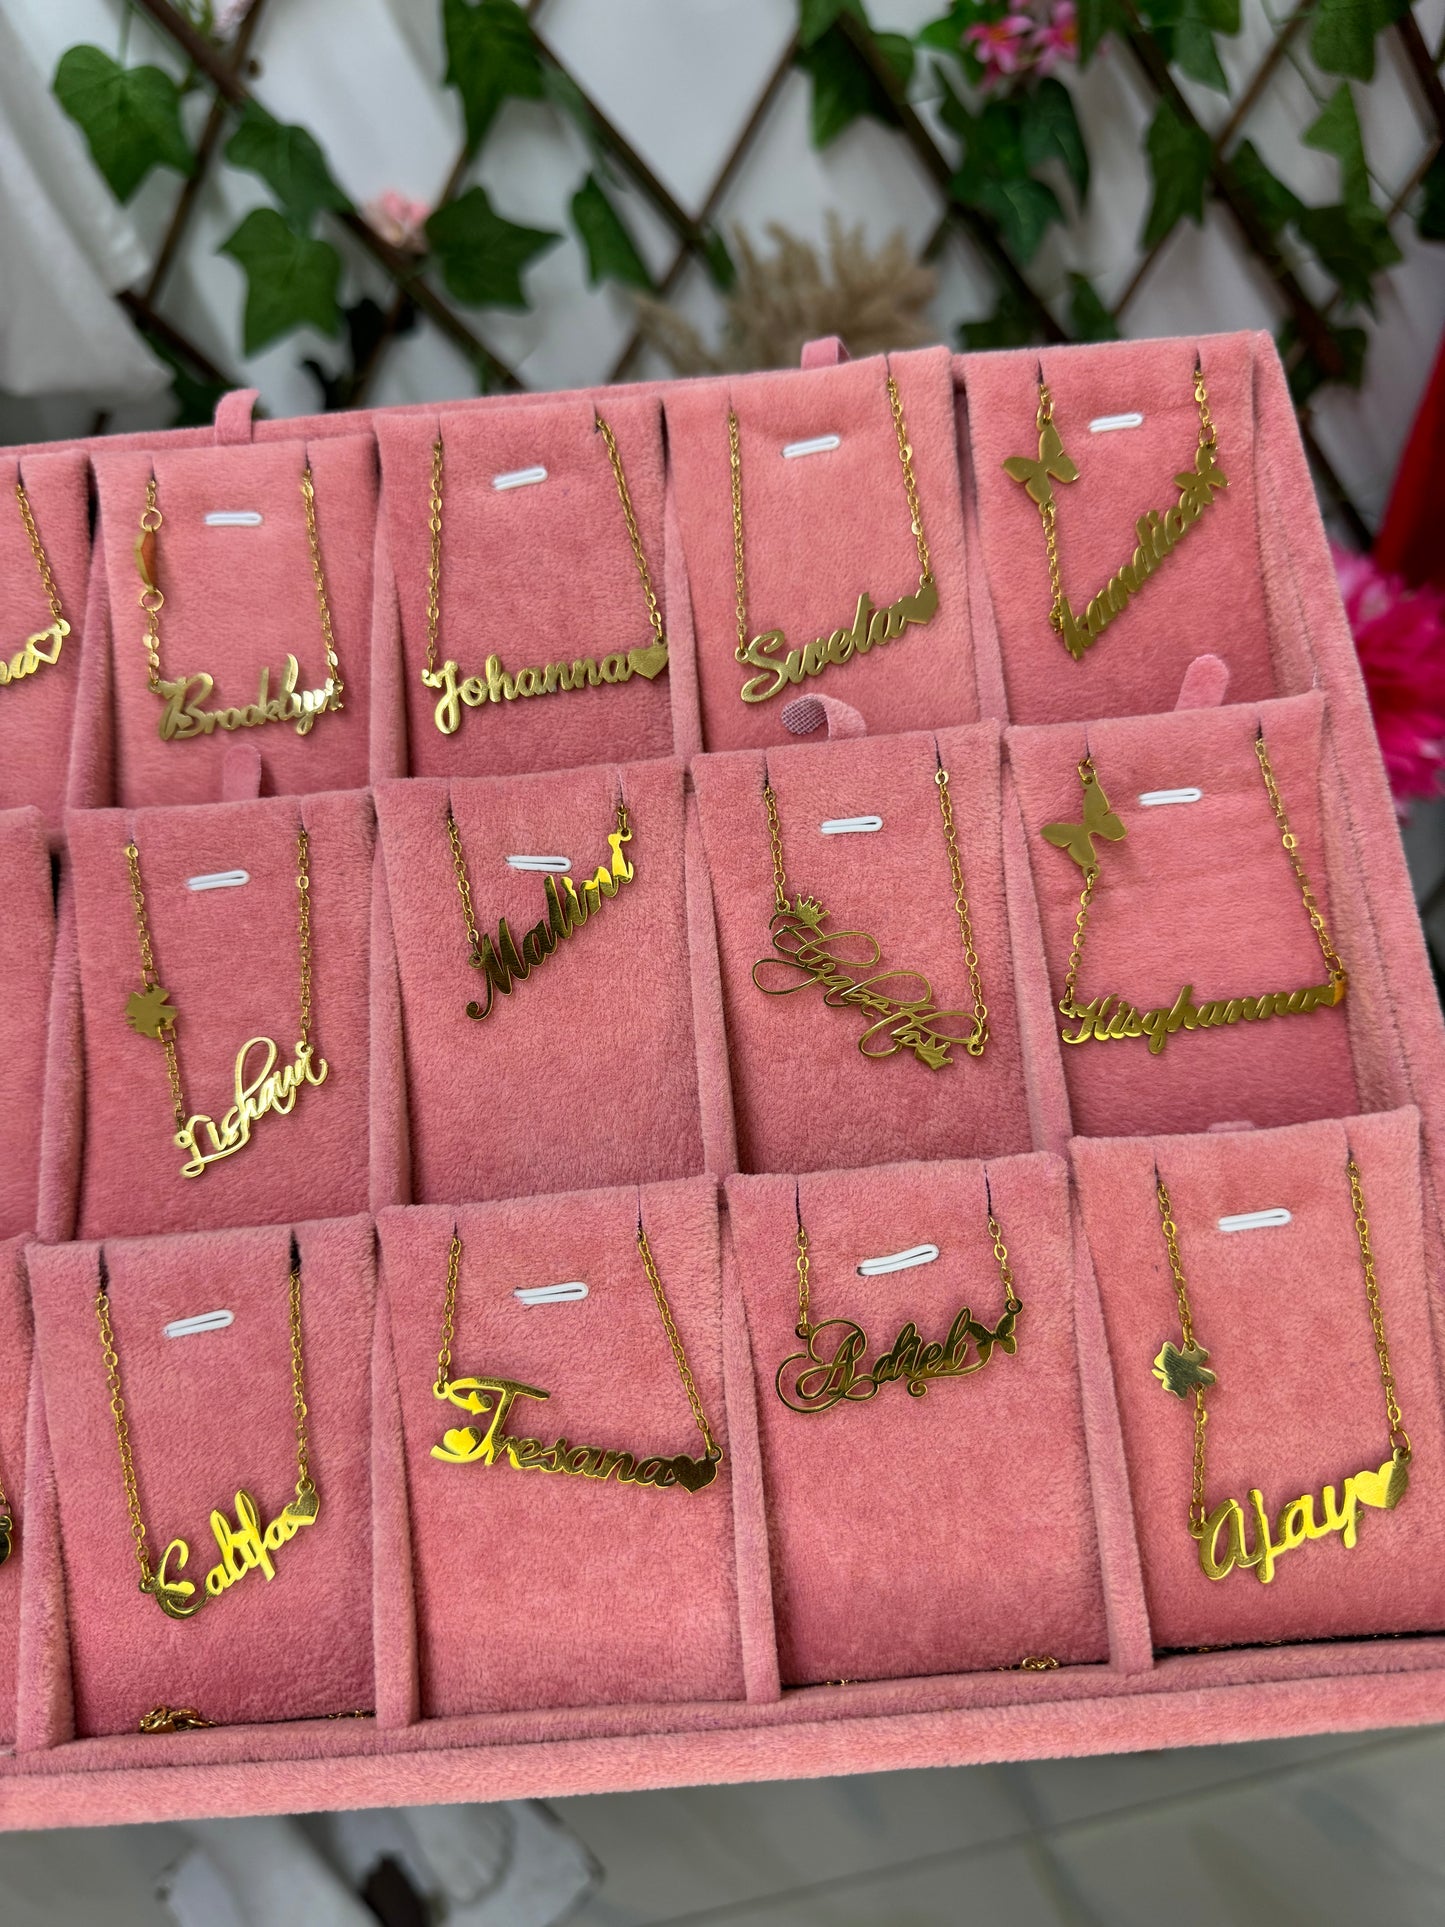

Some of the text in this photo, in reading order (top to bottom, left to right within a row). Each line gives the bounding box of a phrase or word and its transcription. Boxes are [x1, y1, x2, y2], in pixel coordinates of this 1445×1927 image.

[157, 653, 344, 741] Brooklyn
[426, 654, 634, 735] Johanna
[741, 591, 908, 703] Sweta
[466, 833, 634, 1020] Malini
[775, 1307, 970, 1413] Adiel
[430, 1376, 677, 1488] Tresana
